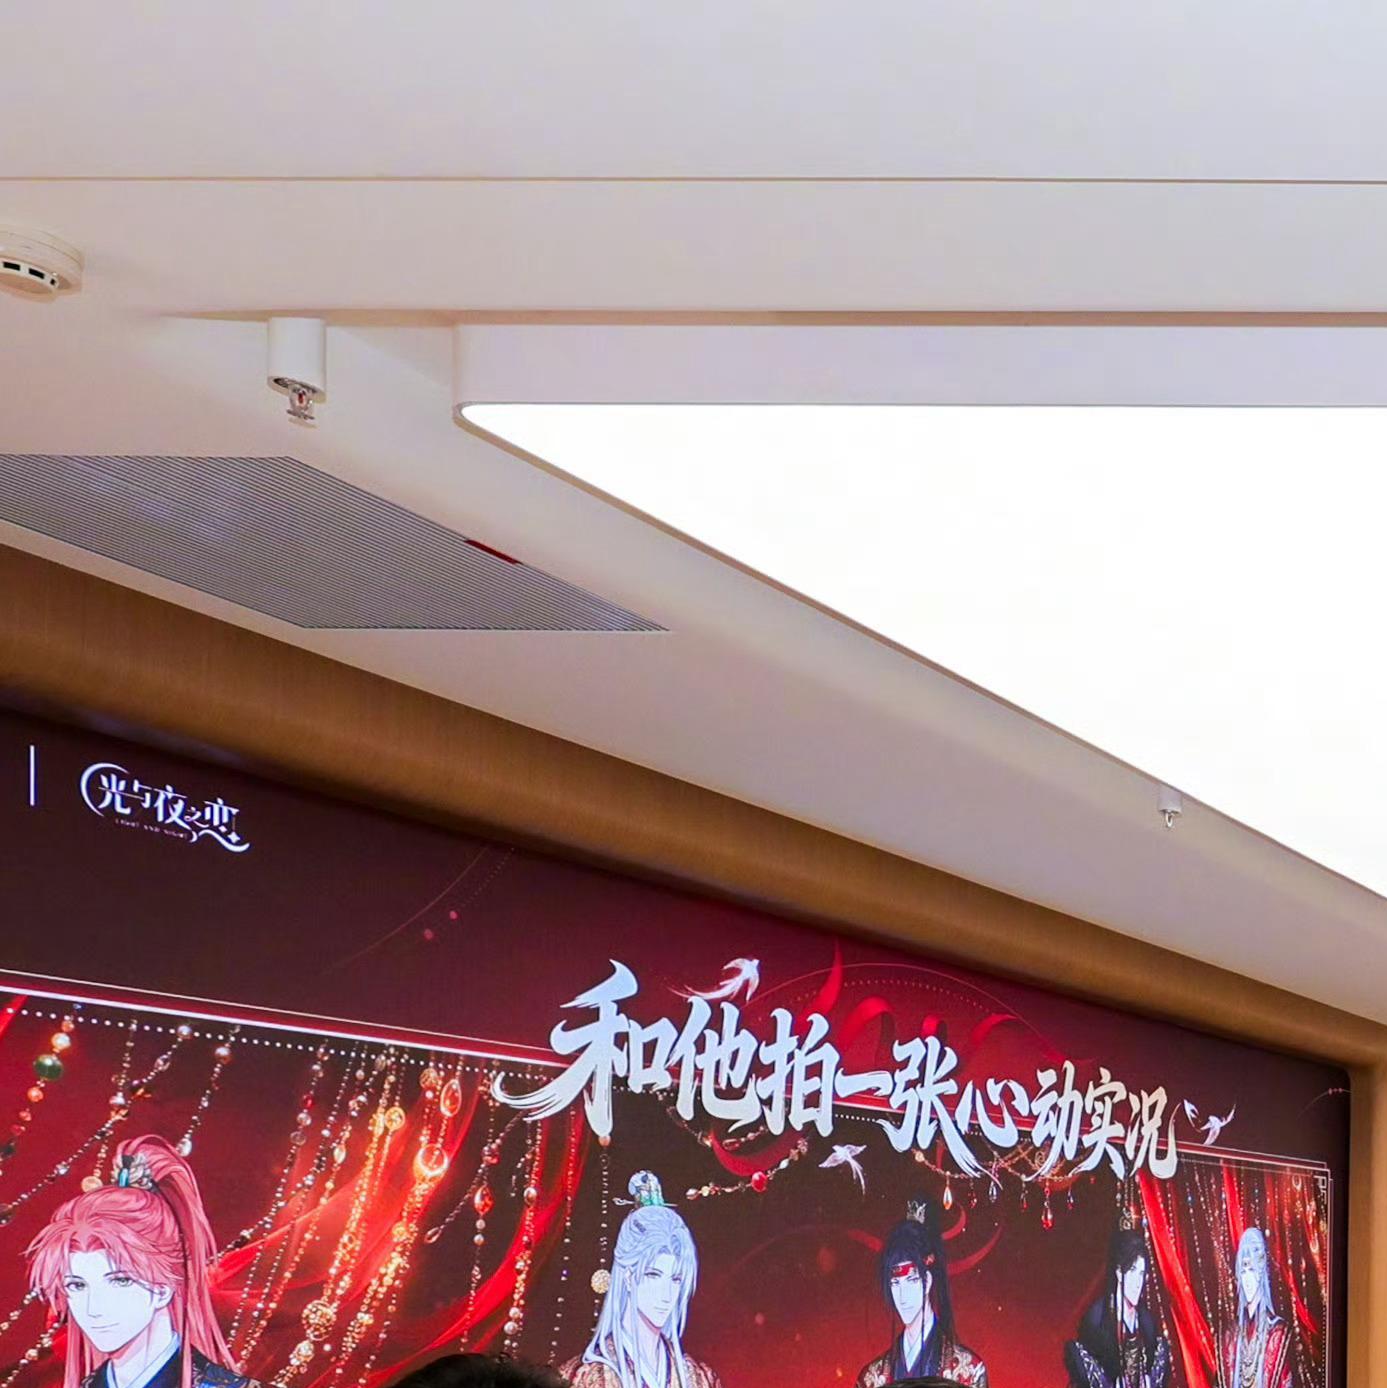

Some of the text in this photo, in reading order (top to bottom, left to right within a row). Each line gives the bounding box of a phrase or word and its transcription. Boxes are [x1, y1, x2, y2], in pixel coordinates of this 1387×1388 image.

[80, 763, 250, 852] 光与夜之恋
[490, 959, 1181, 1188] 和他拍一张心动实况
